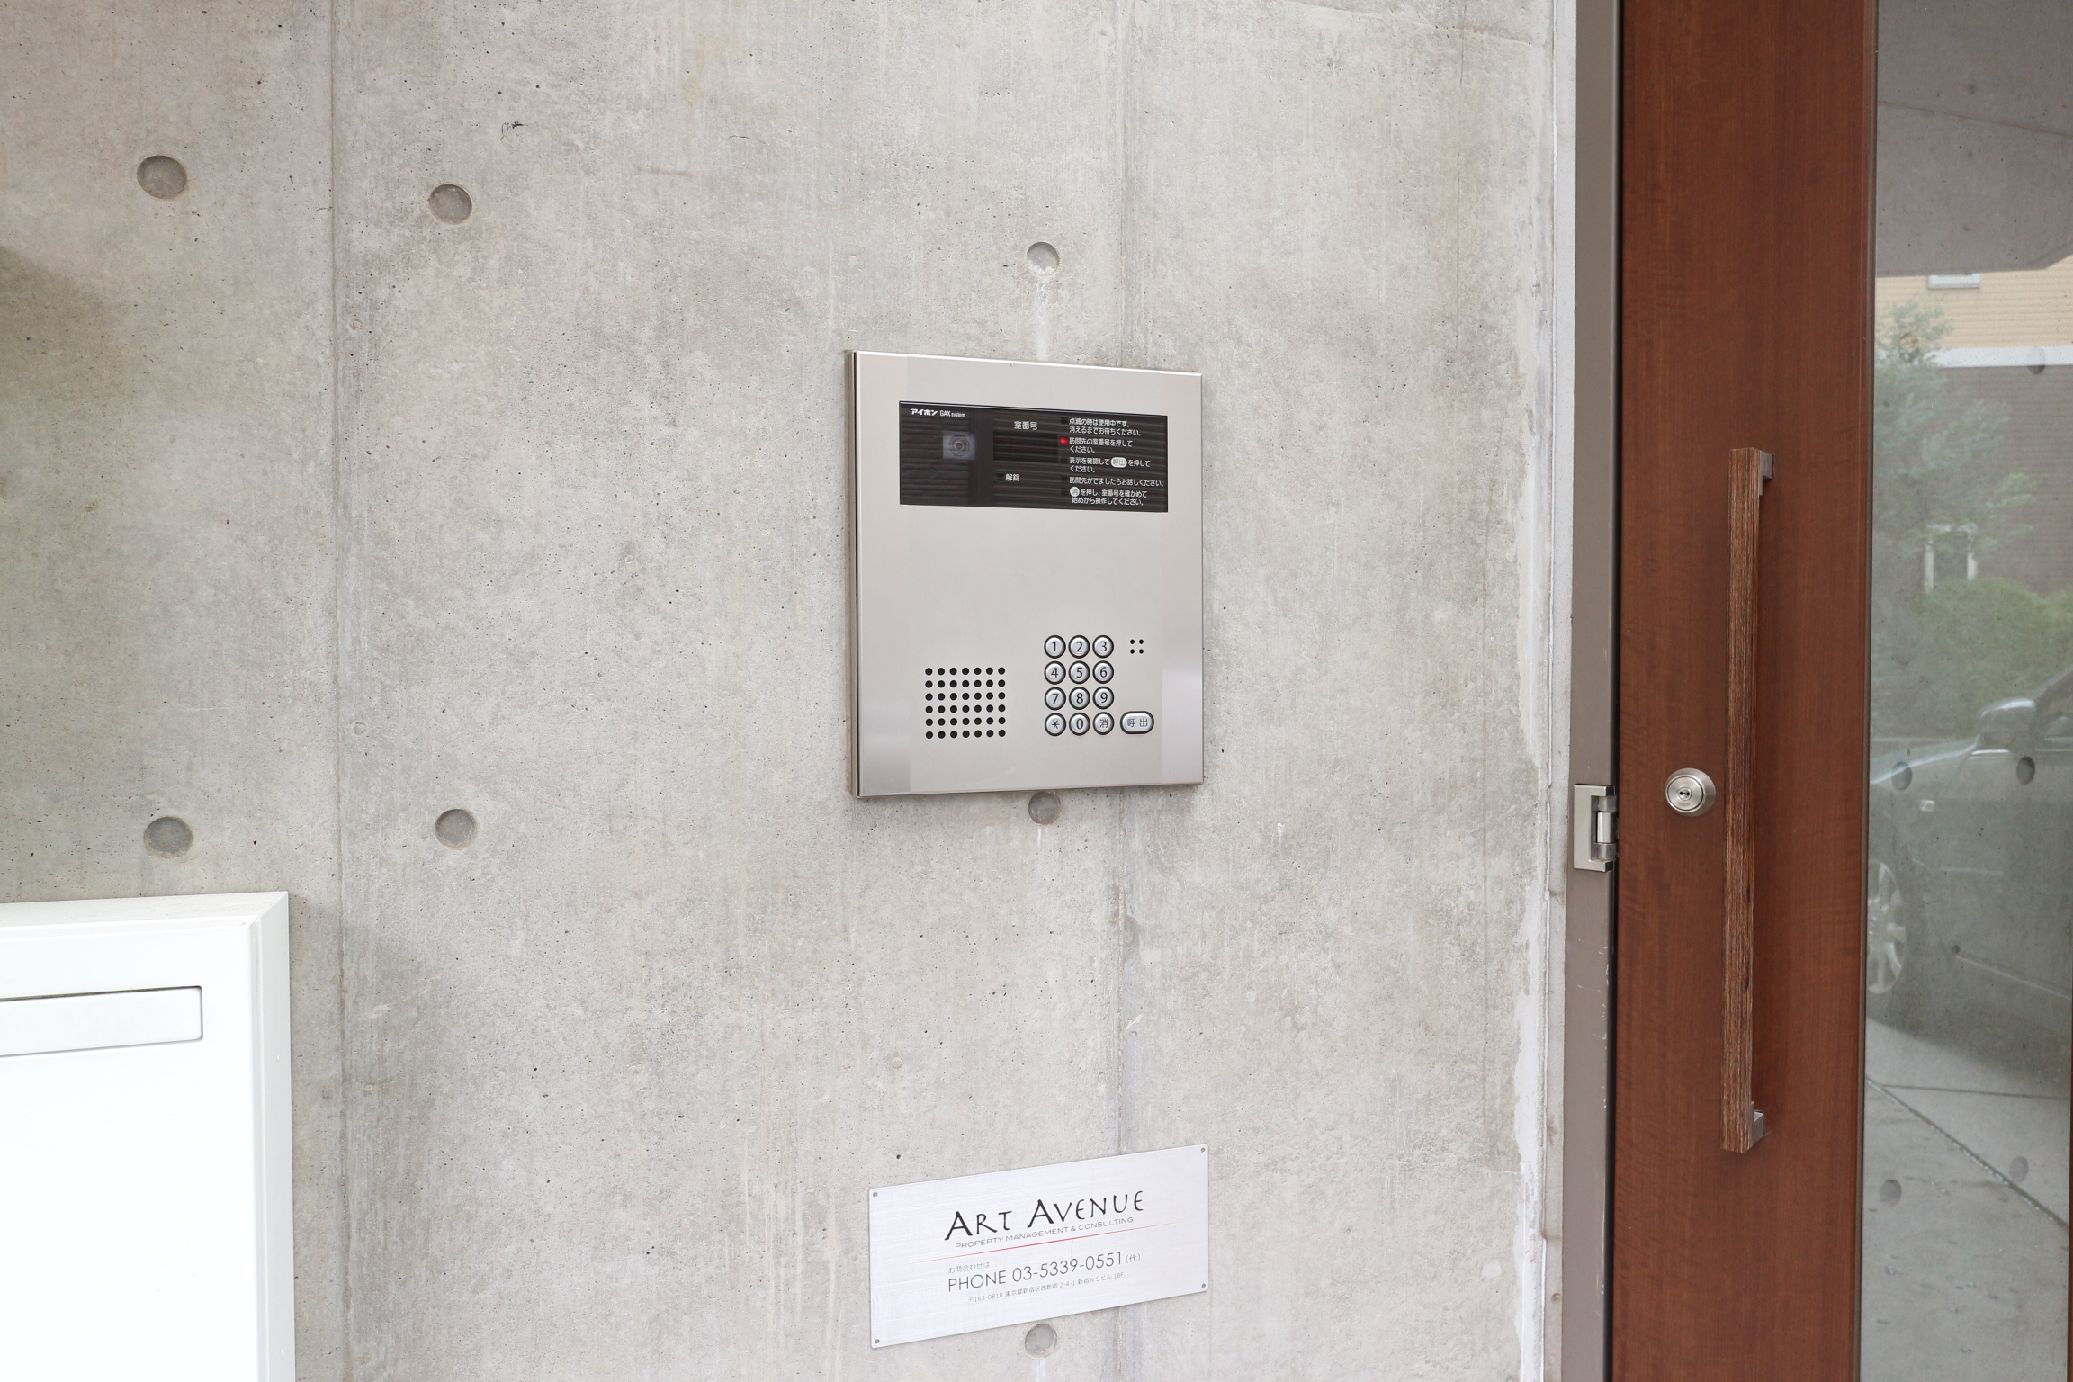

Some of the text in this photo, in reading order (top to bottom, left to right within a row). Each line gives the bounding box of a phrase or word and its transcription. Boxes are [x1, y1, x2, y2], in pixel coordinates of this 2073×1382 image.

[911, 408, 938, 417] アイホン
[1014, 421, 1037, 430] 室番号
[1070, 465, 1095, 473] ください。
[1076, 641, 1083, 652] 2
[1100, 641, 1108, 652] 3
[1050, 667, 1108, 679] 4 5 6
[1052, 692, 1108, 705] 7 8 9
[1076, 718, 1083, 730] 0
[944, 1210, 1013, 1241] ART
[955, 1237, 1003, 1249] PROPERTY
[1005, 1226, 1068, 1242] MANAGEMENT
[1078, 1216, 1134, 1231] CONSULTING
[948, 1269, 1007, 1292] PHONE
[1012, 1251, 1122, 1282] 03-5339-0551
